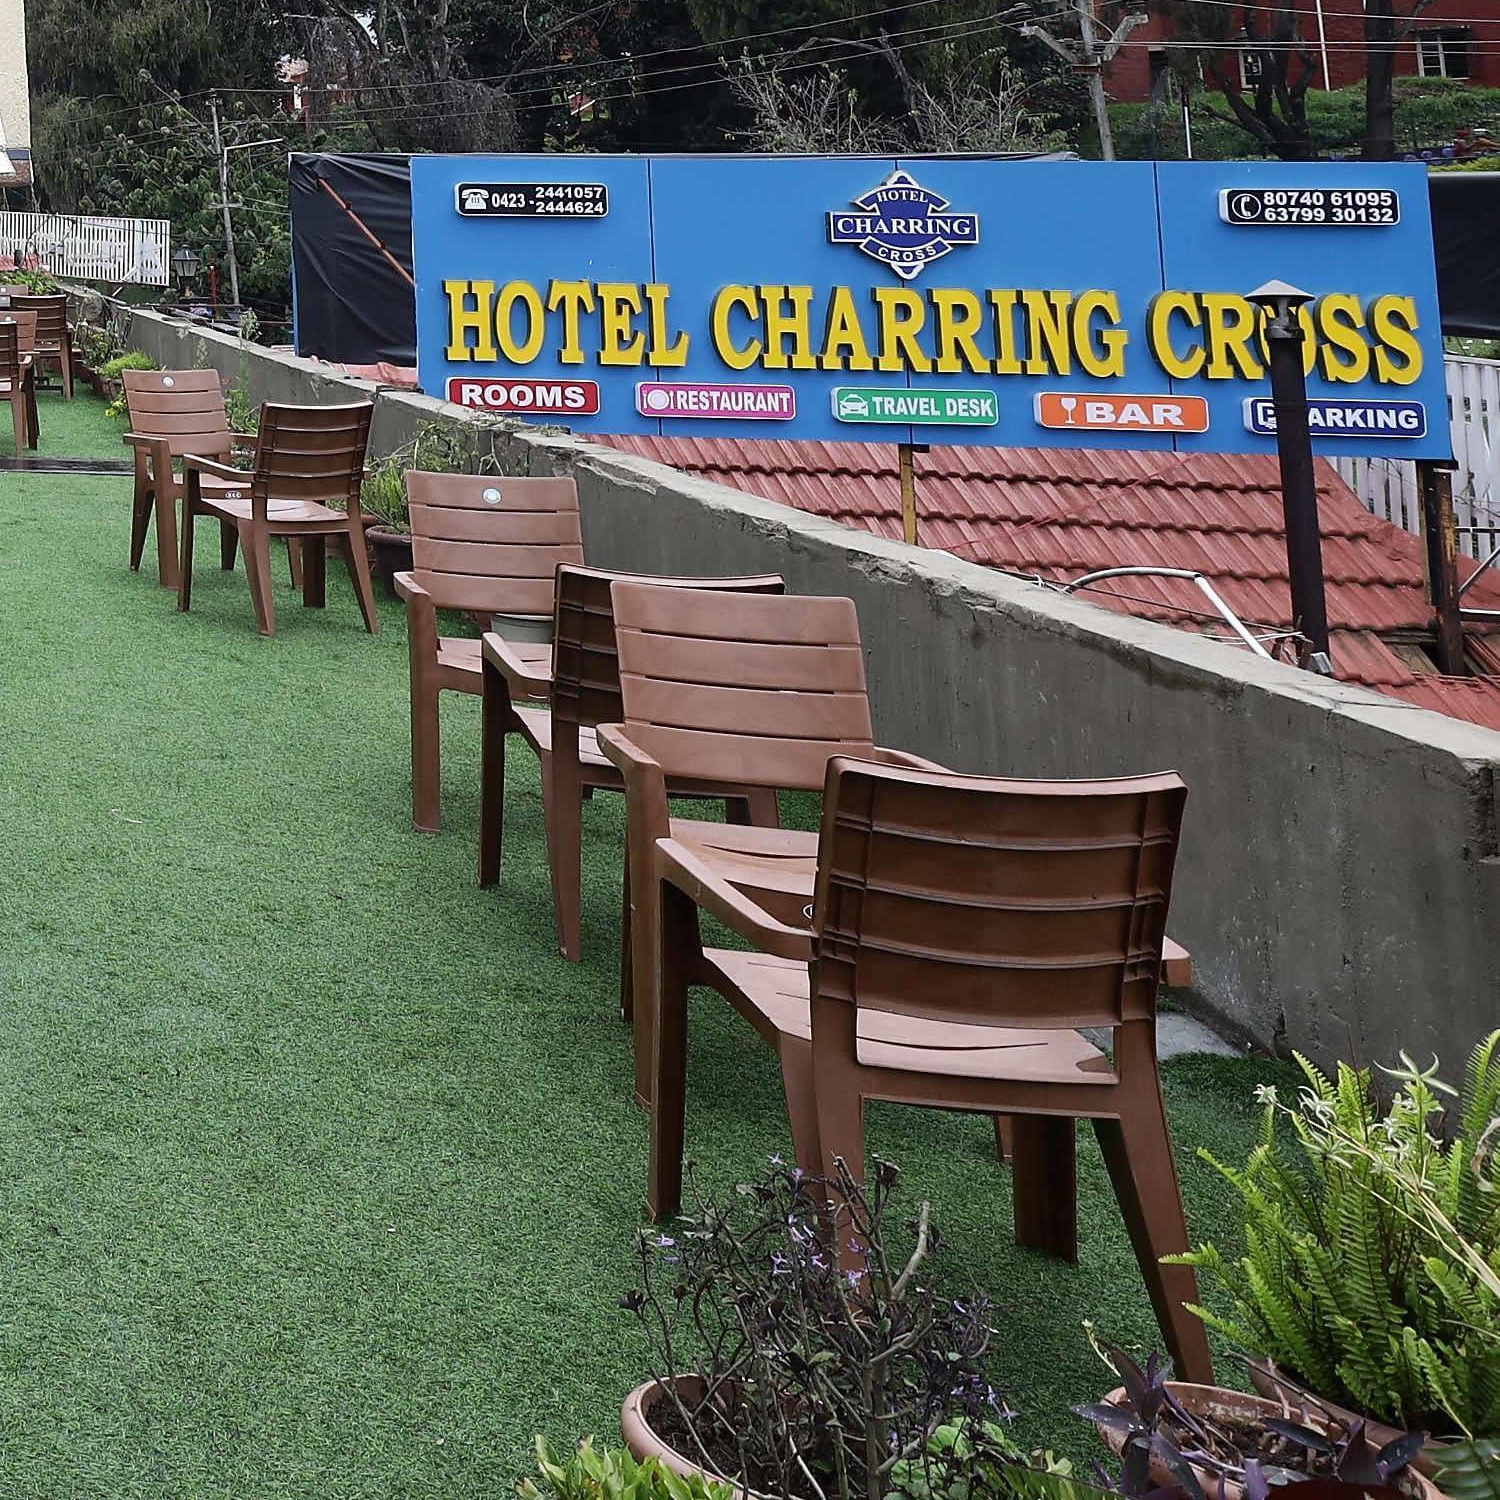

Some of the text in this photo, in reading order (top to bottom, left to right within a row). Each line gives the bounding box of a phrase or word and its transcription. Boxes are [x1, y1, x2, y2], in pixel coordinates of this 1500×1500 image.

[491, 193, 526, 208] 0423
[535, 187, 603, 199] 2441057
[876, 189, 929, 204] HOTEL
[1263, 192, 1392, 206] 80740 61095
[535, 201, 604, 214] 2444624
[1264, 208, 1394, 222] 63799 30132
[837, 217, 972, 236] CHARRING
[878, 245, 937, 262] CROSS
[446, 279, 689, 366] HOTEL
[713, 284, 1128, 378] CHARRING
[461, 383, 587, 408] ROOMS
[678, 390, 791, 414] RESTAURANT
[872, 396, 995, 418] TRAVEL DESK
[1084, 402, 1185, 426] BAR
[1300, 407, 1420, 429] ARKING
